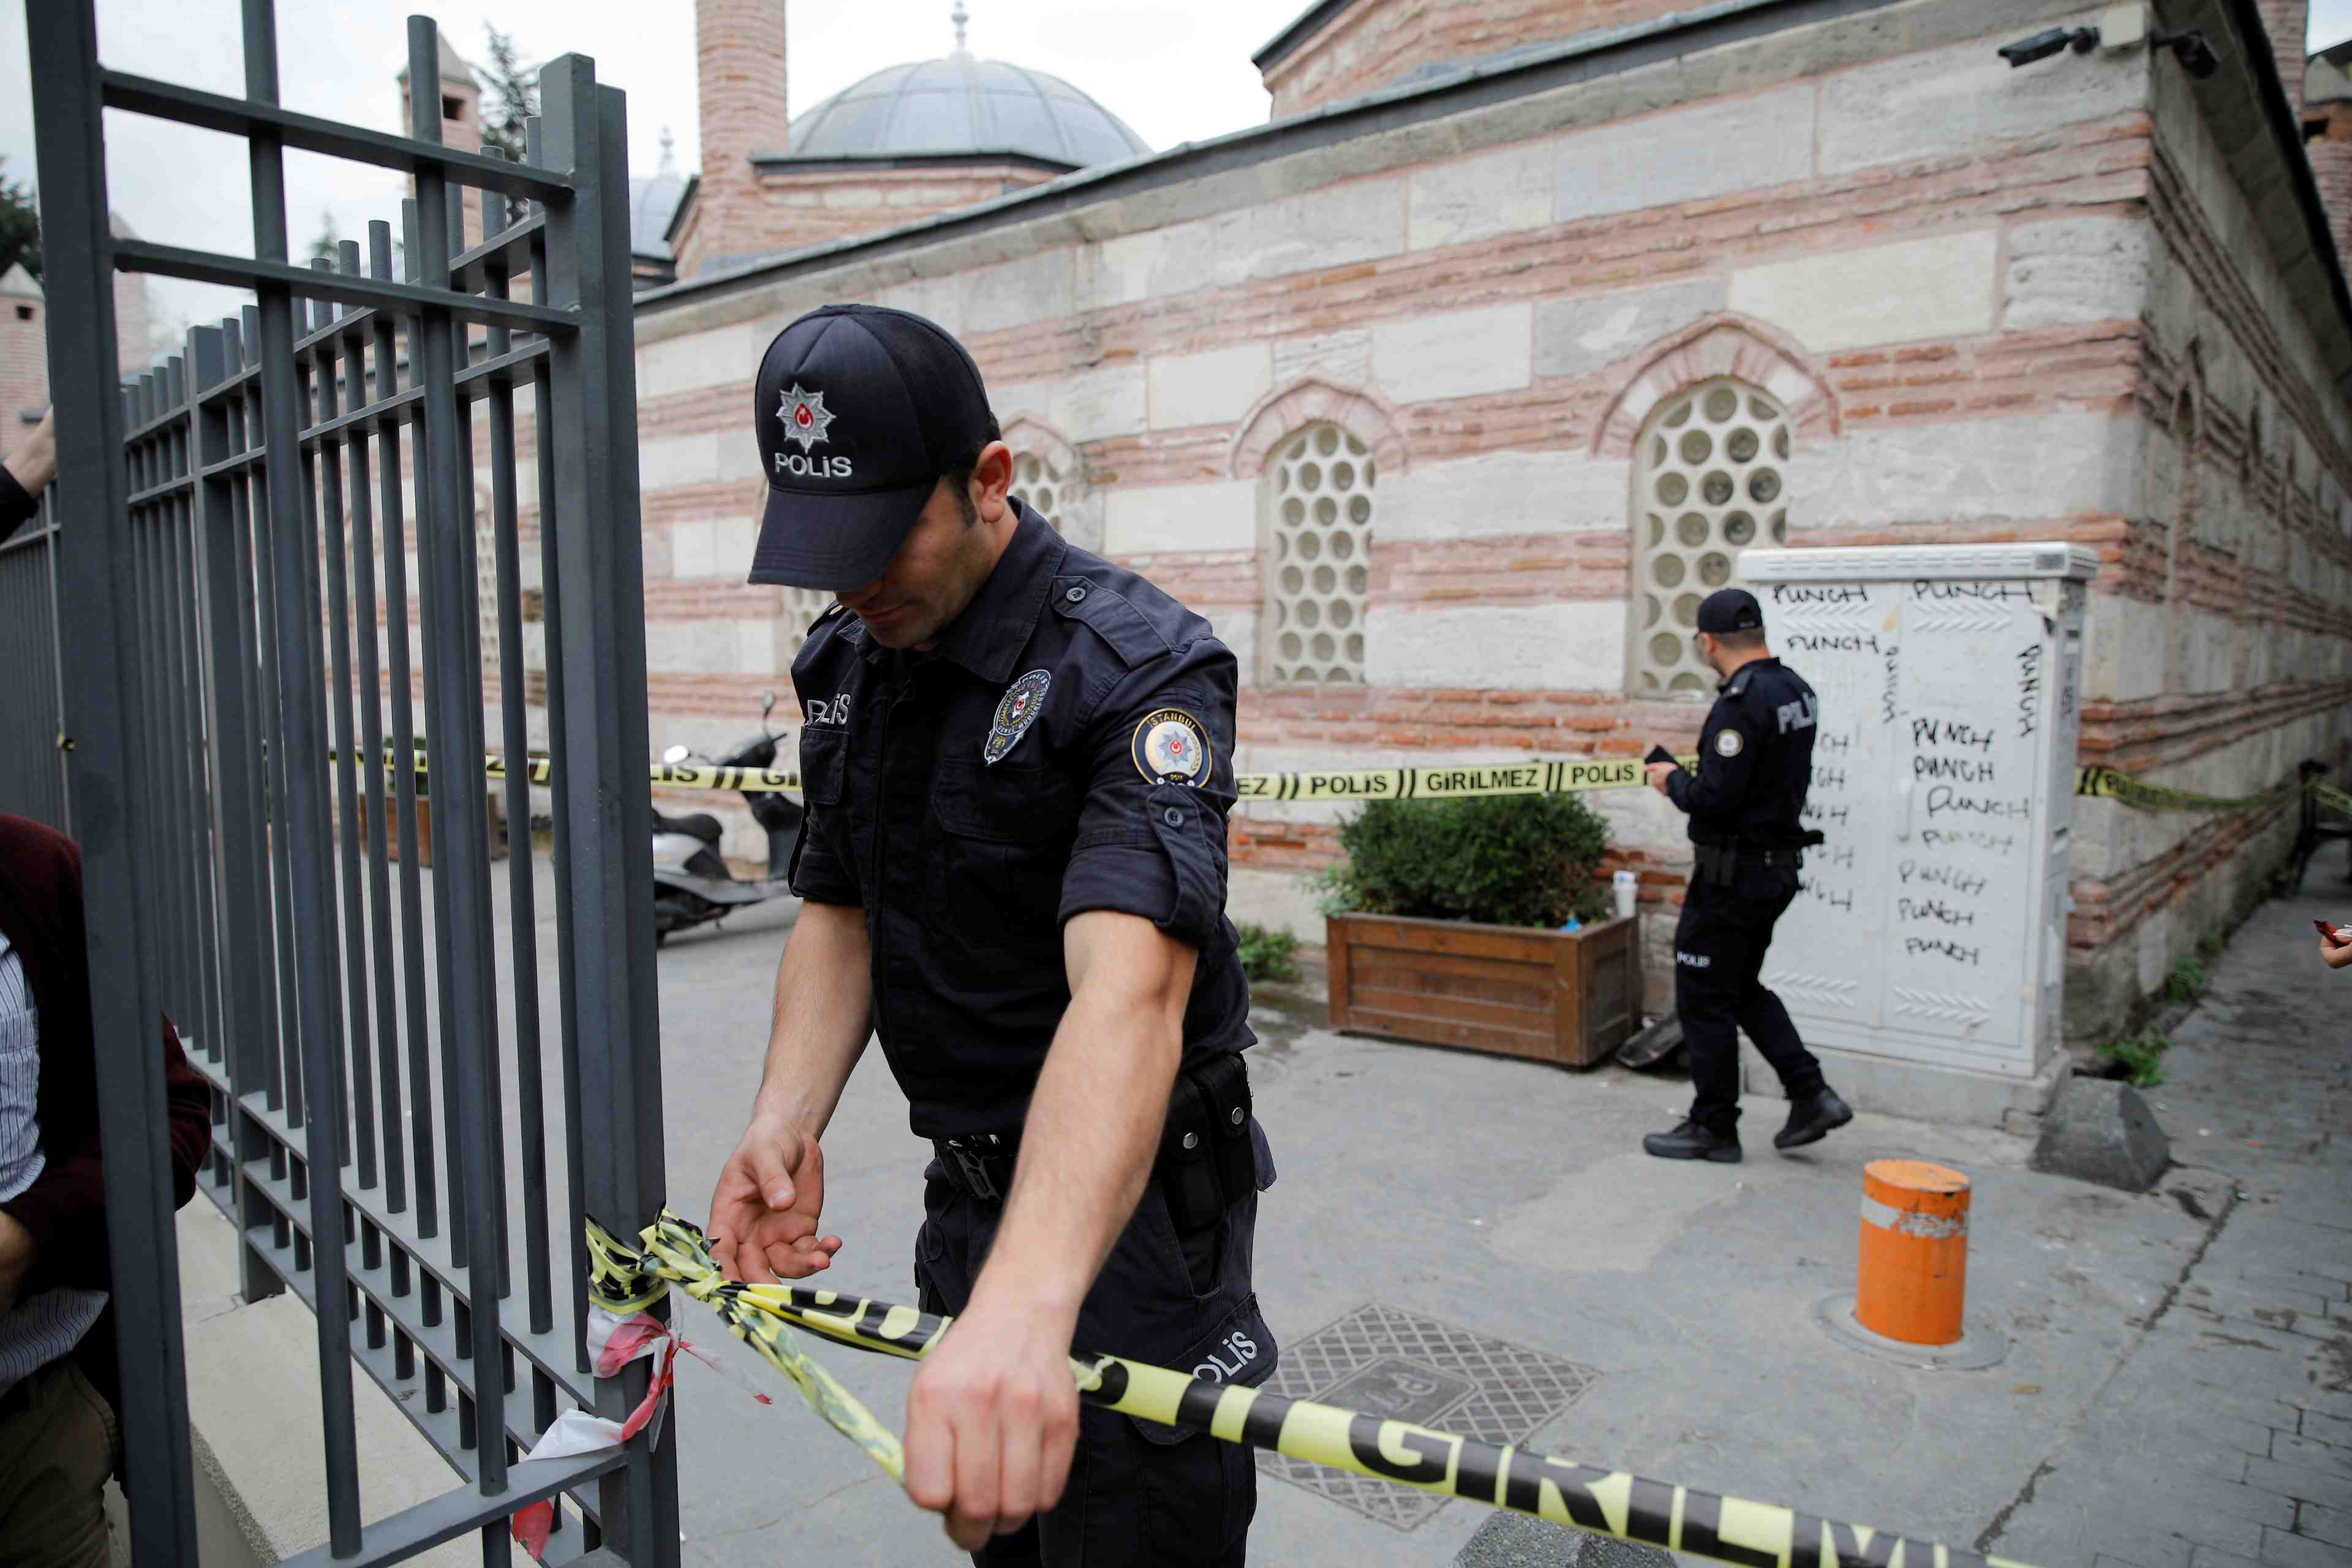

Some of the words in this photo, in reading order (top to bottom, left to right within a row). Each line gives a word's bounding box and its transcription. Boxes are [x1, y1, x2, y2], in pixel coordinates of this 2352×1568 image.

[1774, 584, 1868, 603] PUNCH
[1913, 579, 2034, 603] PUNCH
[1787, 635, 1880, 654] PUNCH
[1192, 1331, 1258, 1383] OLİS
